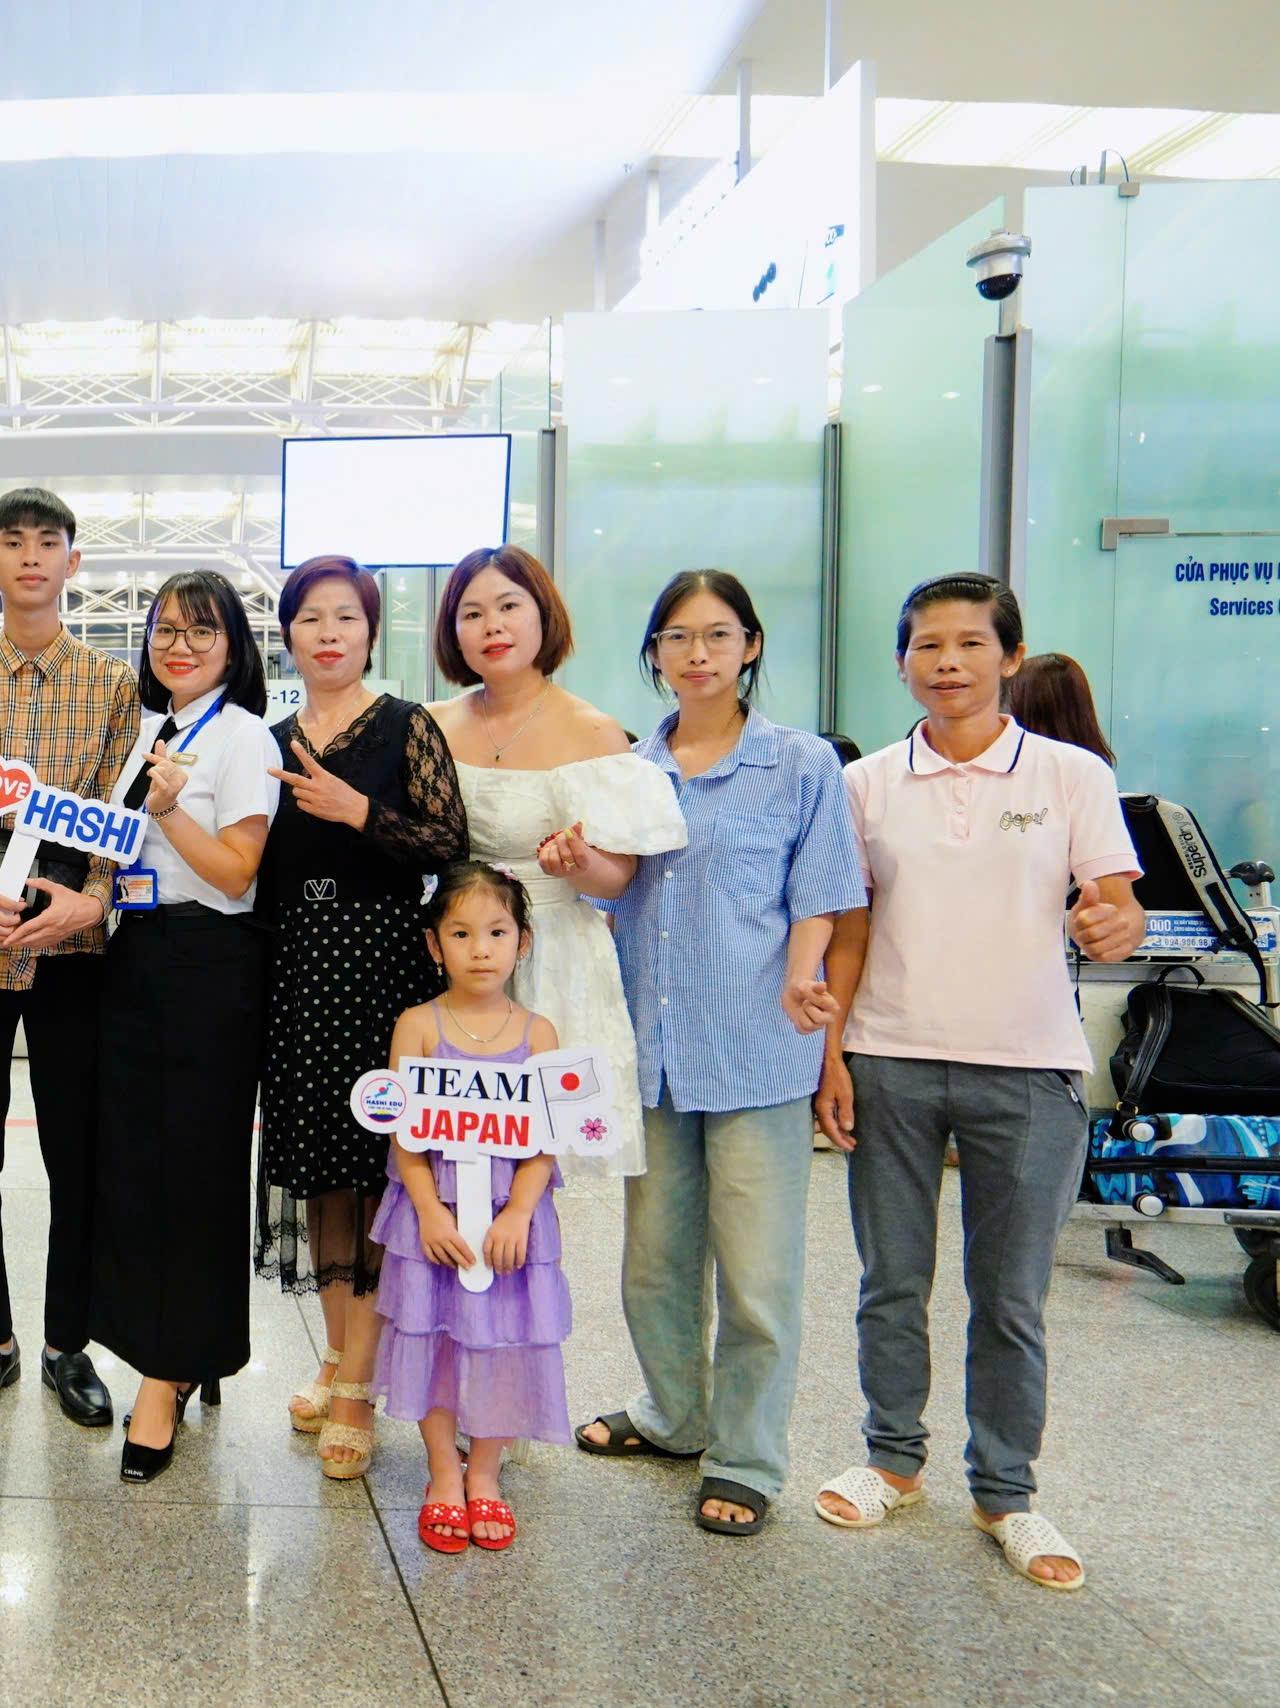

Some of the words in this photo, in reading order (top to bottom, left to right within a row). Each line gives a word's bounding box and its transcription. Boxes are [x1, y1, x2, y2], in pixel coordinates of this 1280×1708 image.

[1175, 556, 1205, 582] CỬA
[1210, 562, 1249, 585] PHỤC
[1254, 562, 1273, 585] VỤ
[1210, 598, 1273, 616] Services
[23, 789, 141, 855] HASHI
[409, 1065, 533, 1104] TEAM
[410, 1107, 529, 1147] JAPAN
